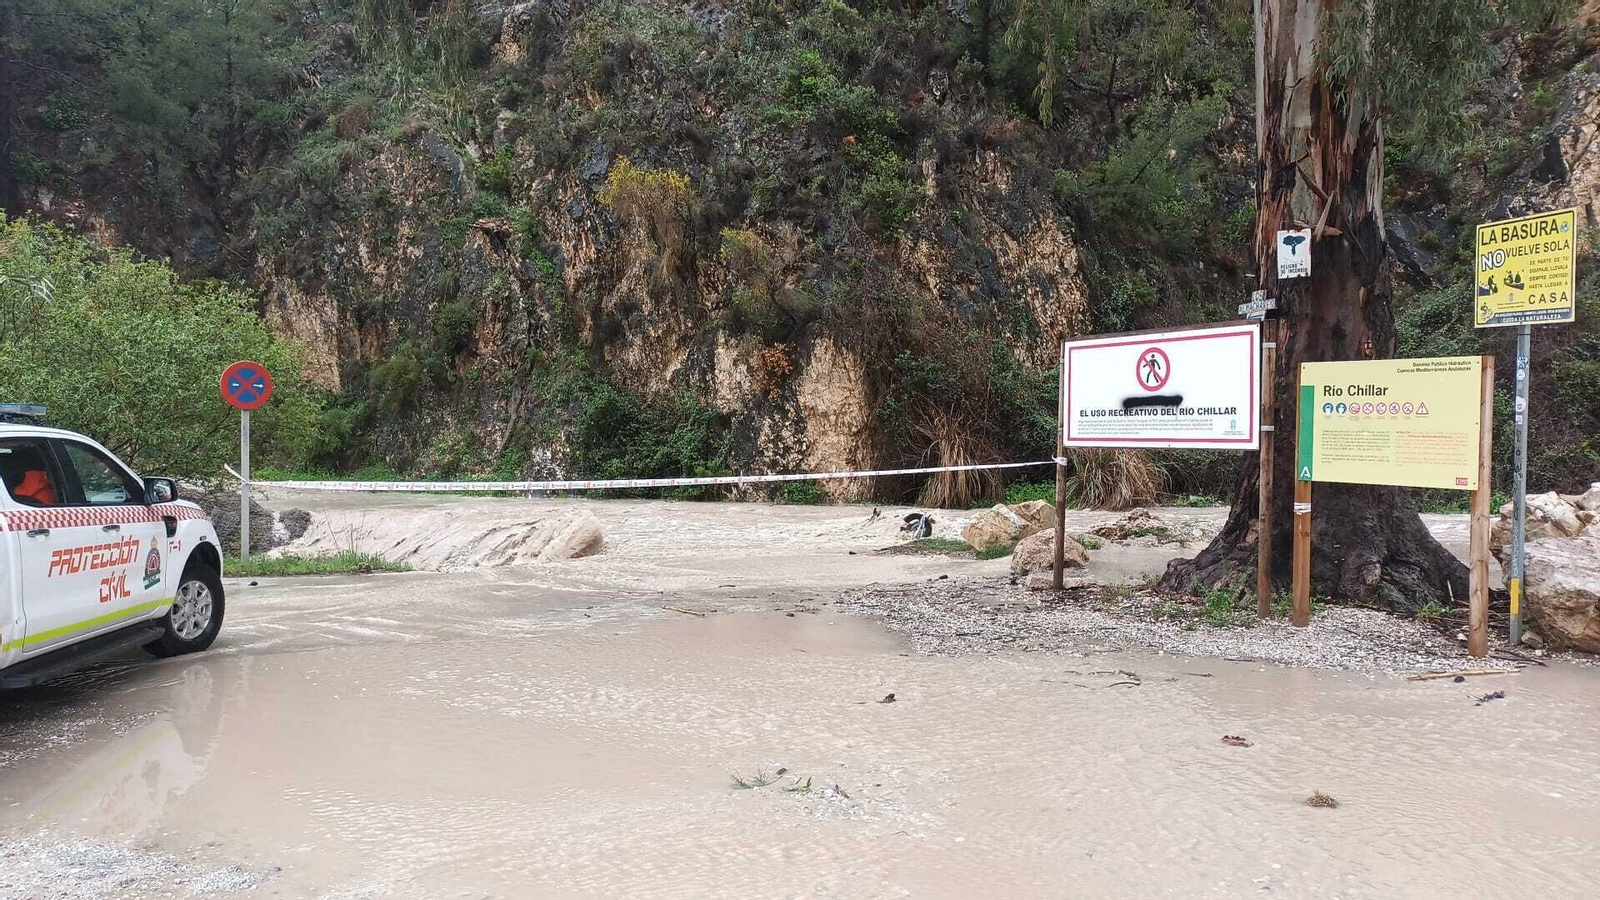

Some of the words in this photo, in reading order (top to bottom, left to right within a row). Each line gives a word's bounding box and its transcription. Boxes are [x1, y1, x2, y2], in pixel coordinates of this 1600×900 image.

[1481, 229, 1497, 246] LA
[1501, 219, 1559, 243] BASURA
[1480, 249, 1506, 272] NO
[1506, 243, 1541, 258] VUELVE
[1543, 239, 1570, 253] SOLA
[1526, 313, 1561, 321] NATURALEZA
[1079, 409, 1089, 417] EL
[1090, 409, 1107, 417] USO
[1108, 408, 1158, 417] RECREATIVO
[1160, 408, 1177, 416] DEL
